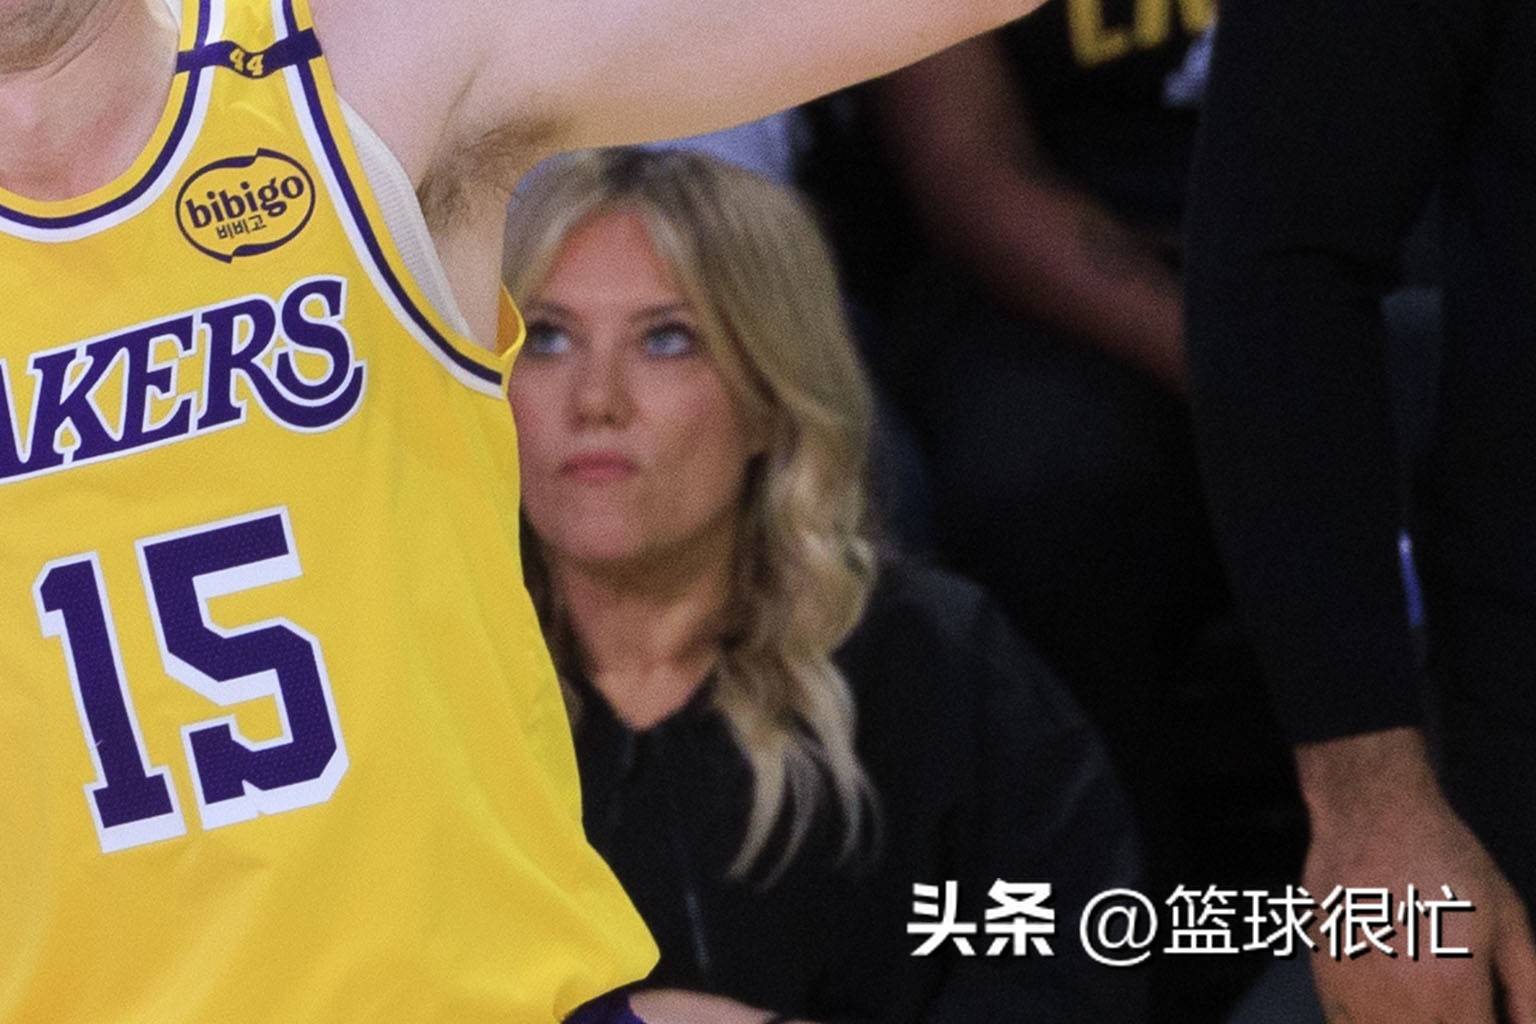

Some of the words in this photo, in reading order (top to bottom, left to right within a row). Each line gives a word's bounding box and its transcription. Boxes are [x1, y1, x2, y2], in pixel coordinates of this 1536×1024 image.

[229, 47, 265, 77] 44
[185, 175, 305, 229] bibigo
[216, 214, 268, 240] 비비고
[31, 504, 350, 854] 15
